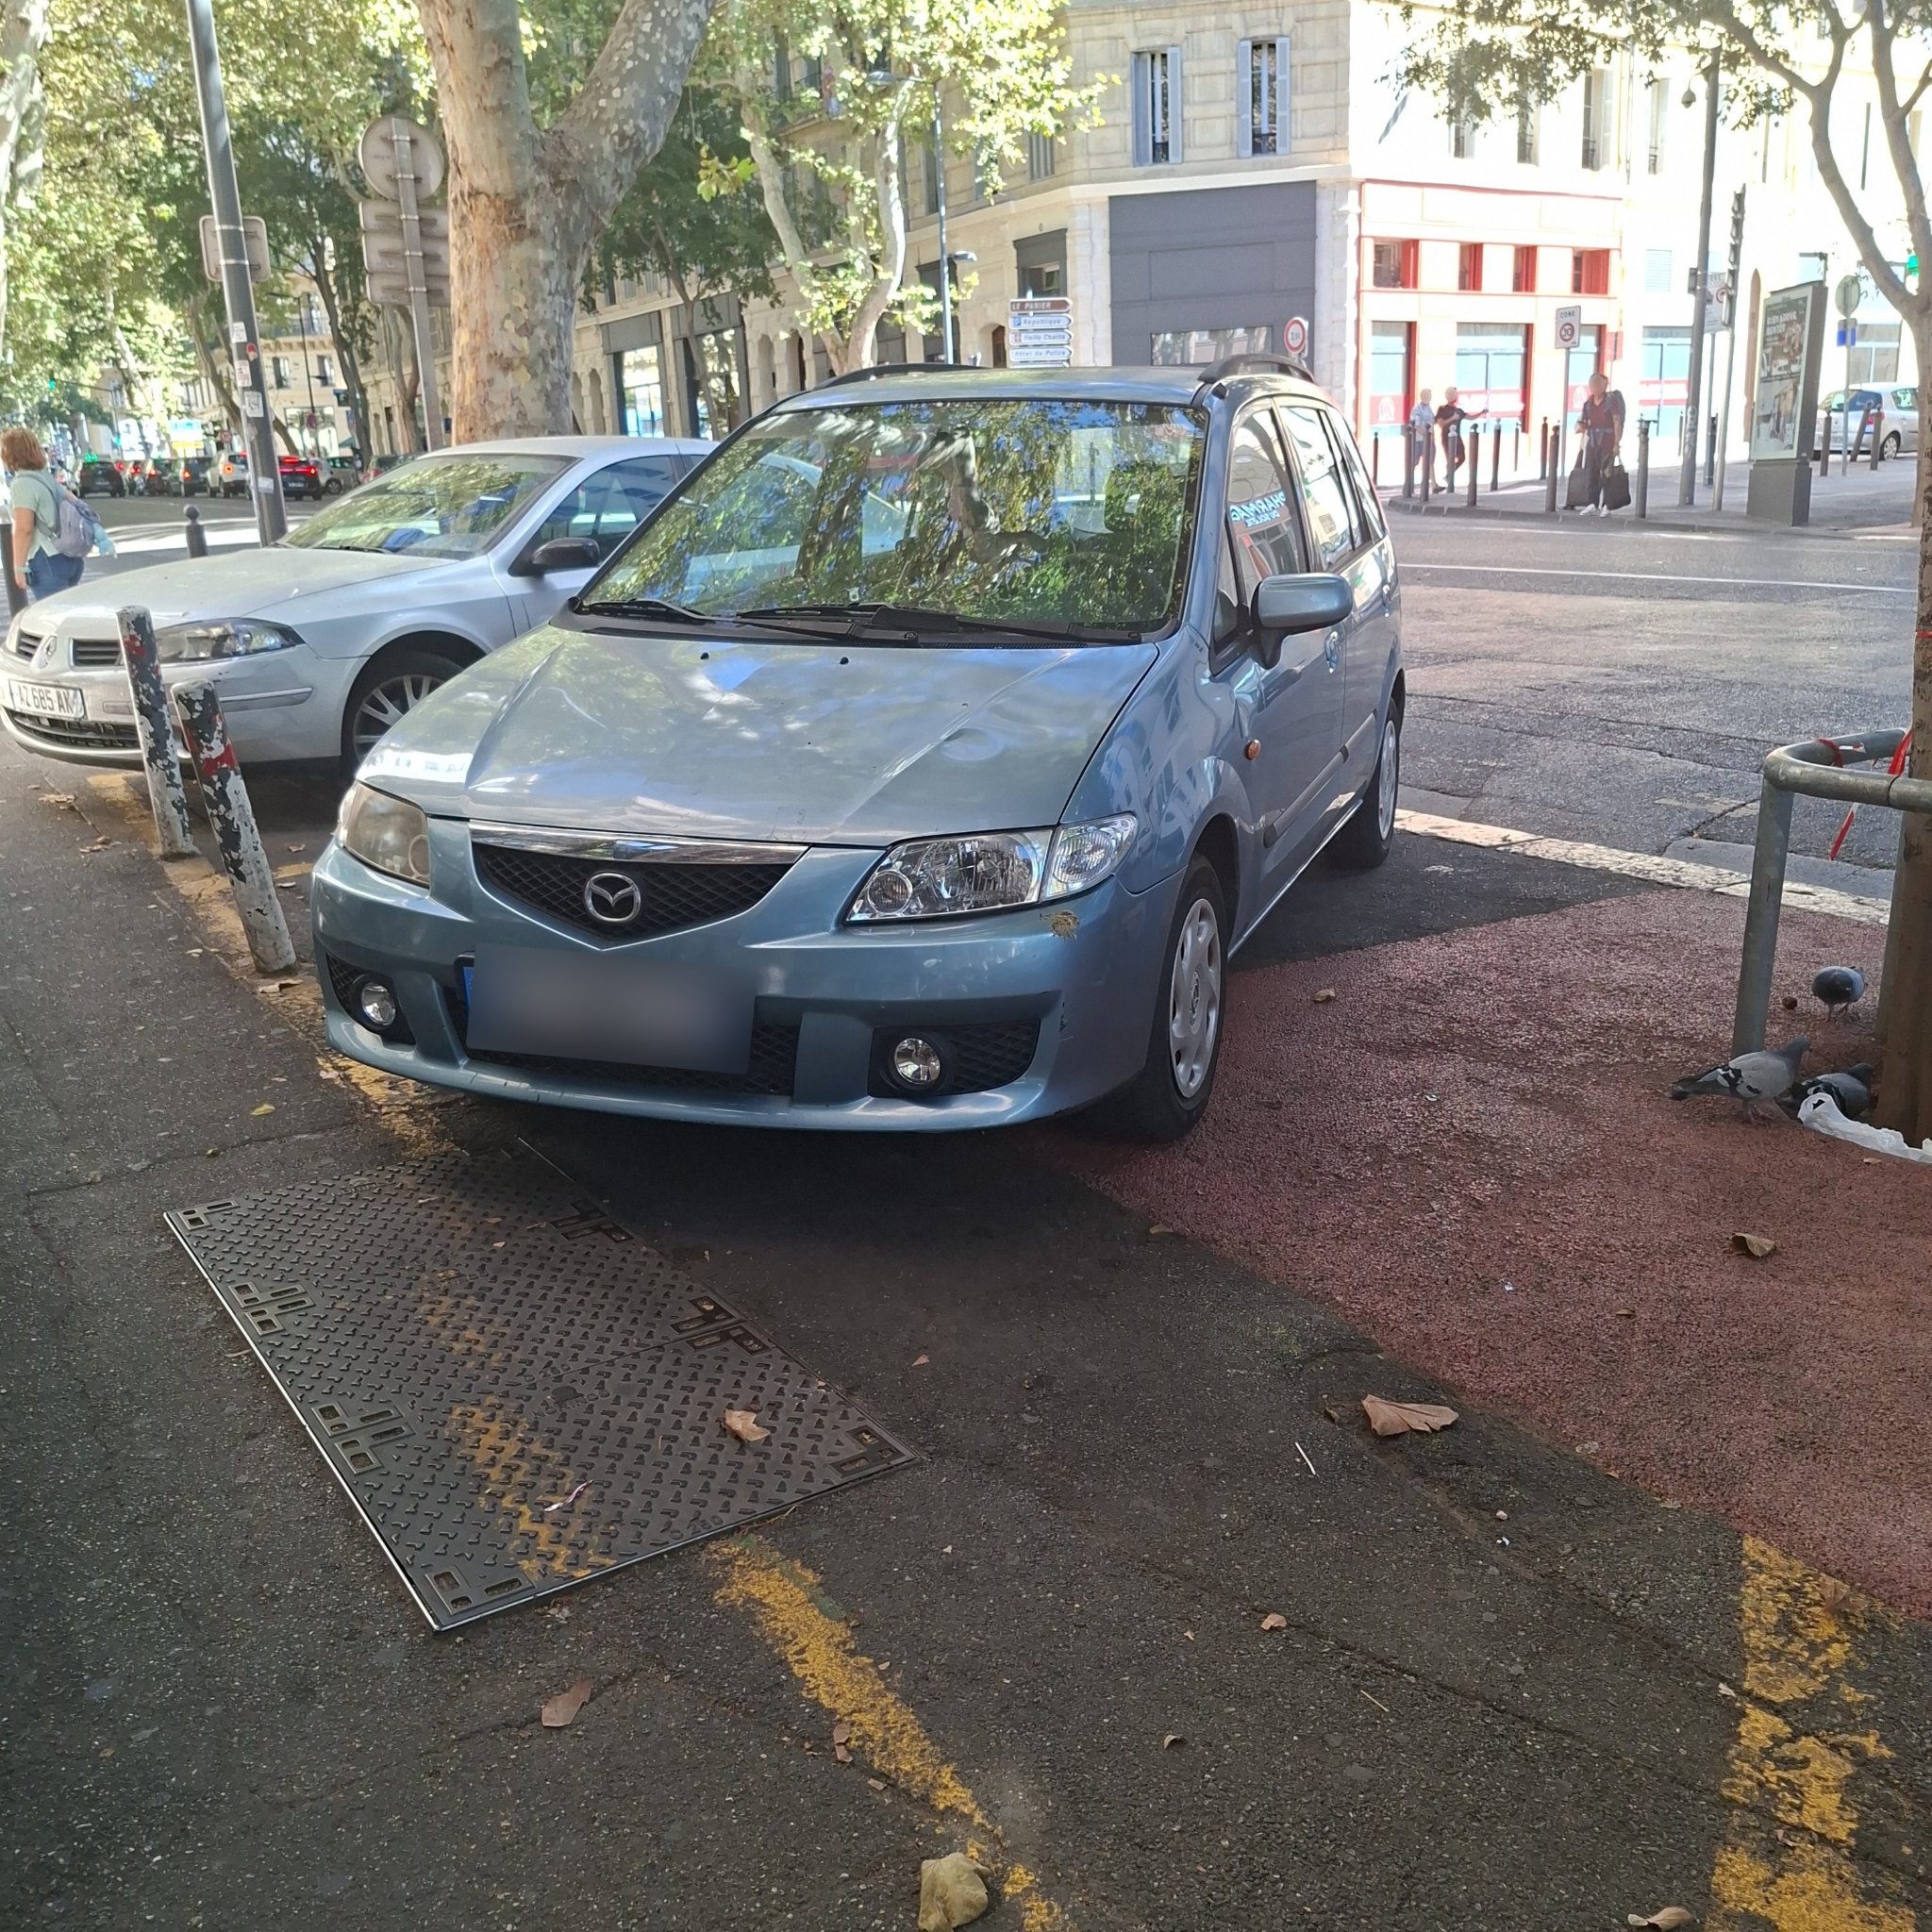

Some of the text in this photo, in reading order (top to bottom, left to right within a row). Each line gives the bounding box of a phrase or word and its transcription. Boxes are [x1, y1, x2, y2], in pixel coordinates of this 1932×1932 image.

[1011, 301, 1052, 310] LE PANIER
[1562, 326, 1574, 338] 30
[31, 687, 56, 711] 685
